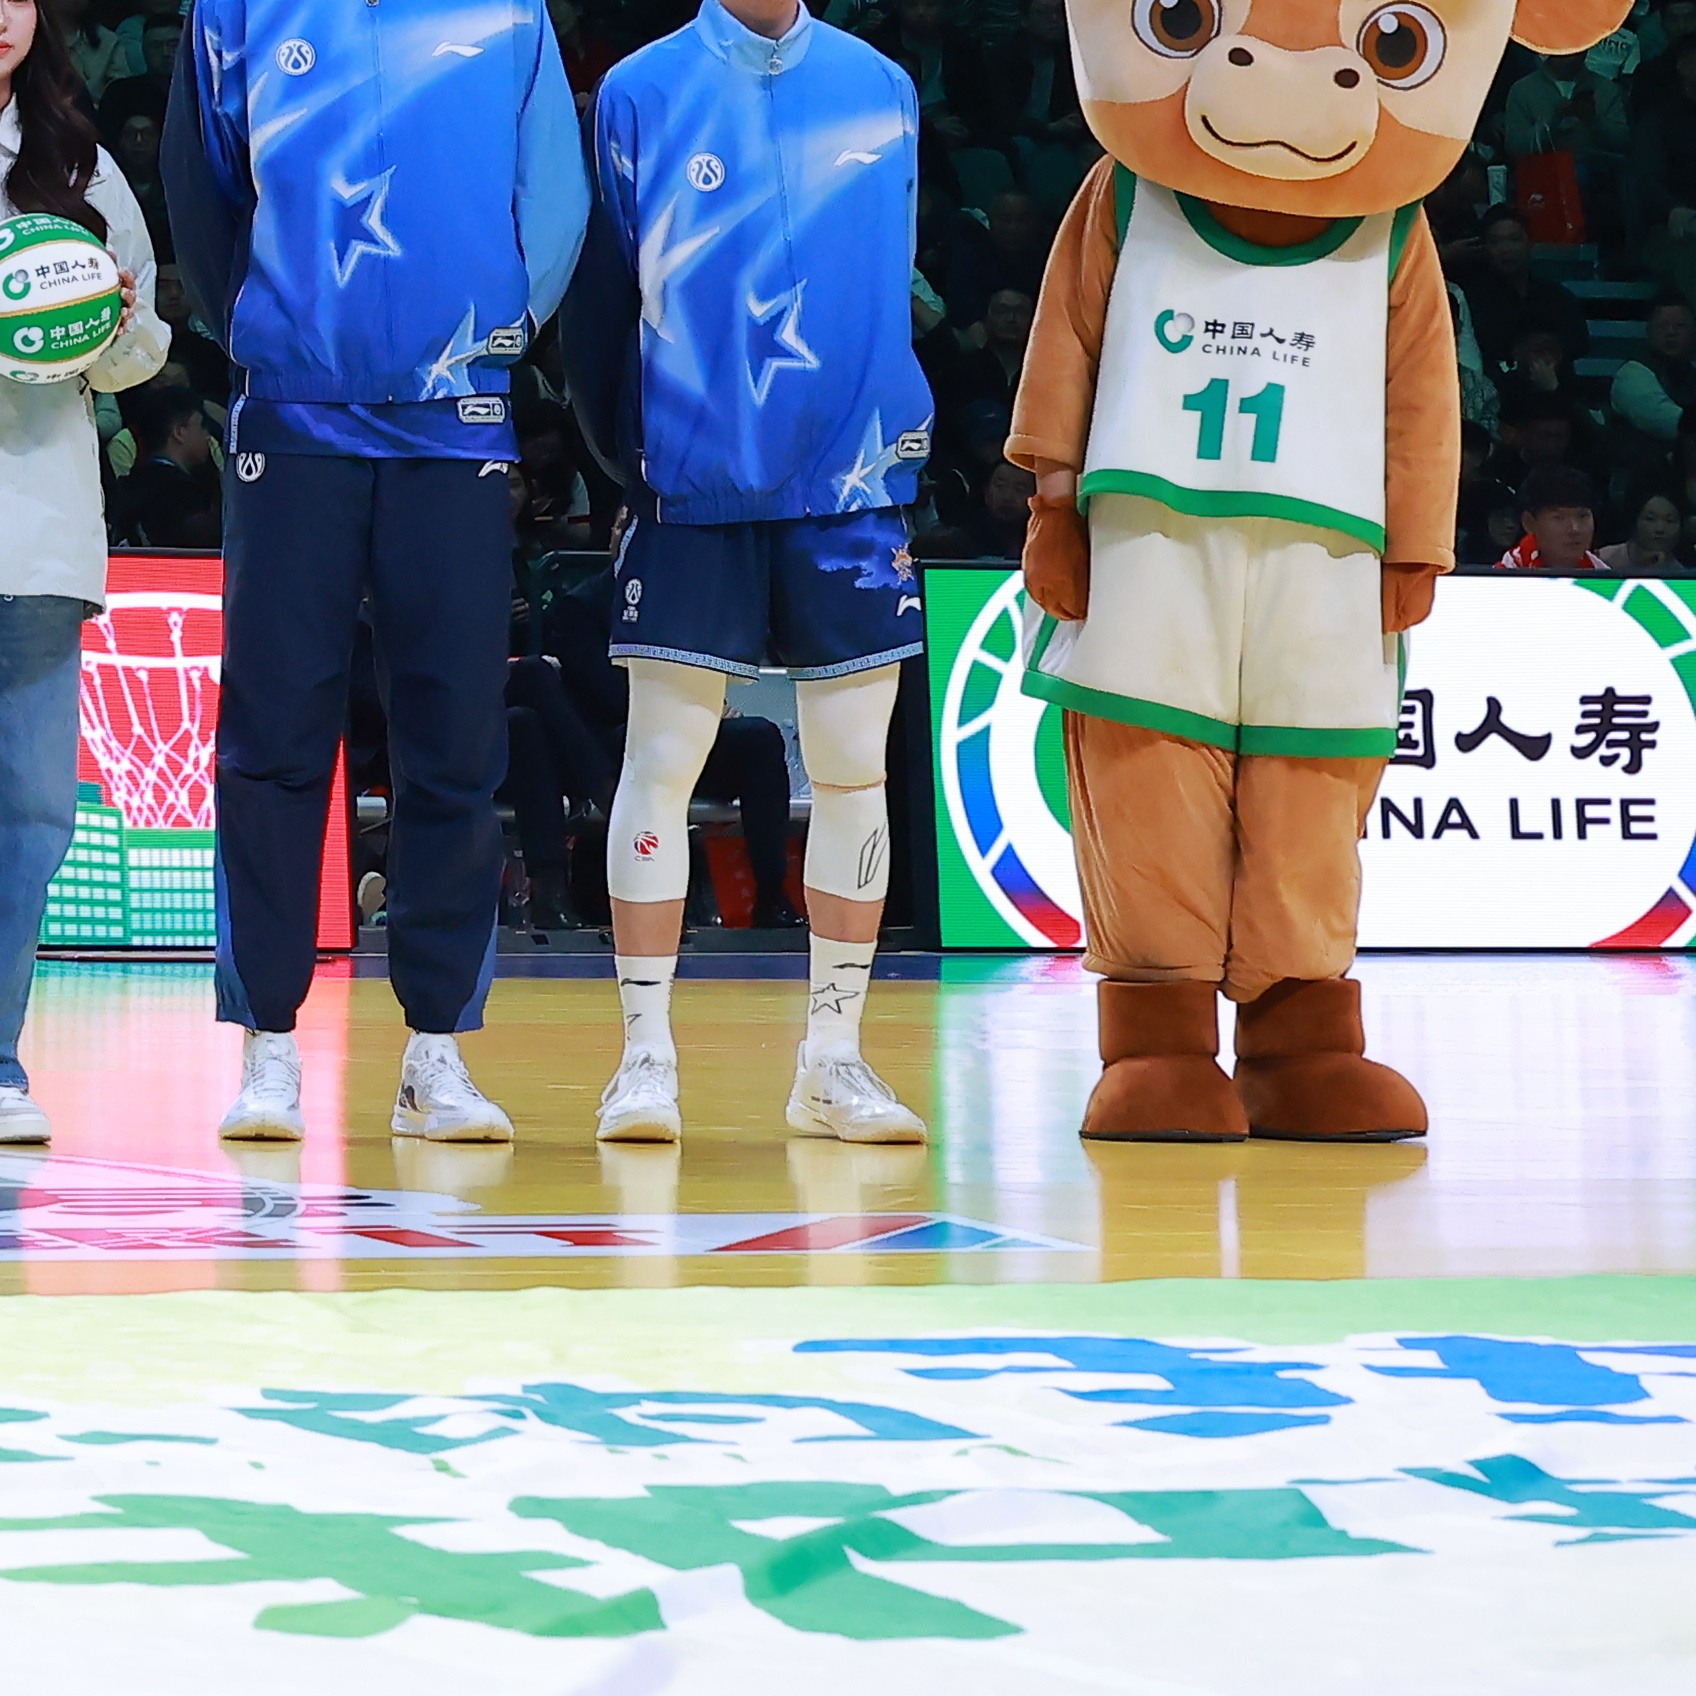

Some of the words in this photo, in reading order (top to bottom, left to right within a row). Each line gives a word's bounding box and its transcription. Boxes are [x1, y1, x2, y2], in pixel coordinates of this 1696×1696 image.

[35, 257, 101, 280] 中国人寿
[39, 275, 80, 291] CHINA
[81, 272, 103, 282] LIFE
[49, 306, 113, 342] 中国人寿
[50, 334, 91, 350] CHINA
[92, 322, 112, 339] LIFE
[1203, 318, 1317, 353] 中国人寿
[1201, 343, 1262, 357] CHINA
[1271, 350, 1312, 368] LIFE
[1181, 377, 1286, 464] 11
[1389, 686, 1661, 776] 国人寿
[1509, 797, 1659, 841] LIFE
